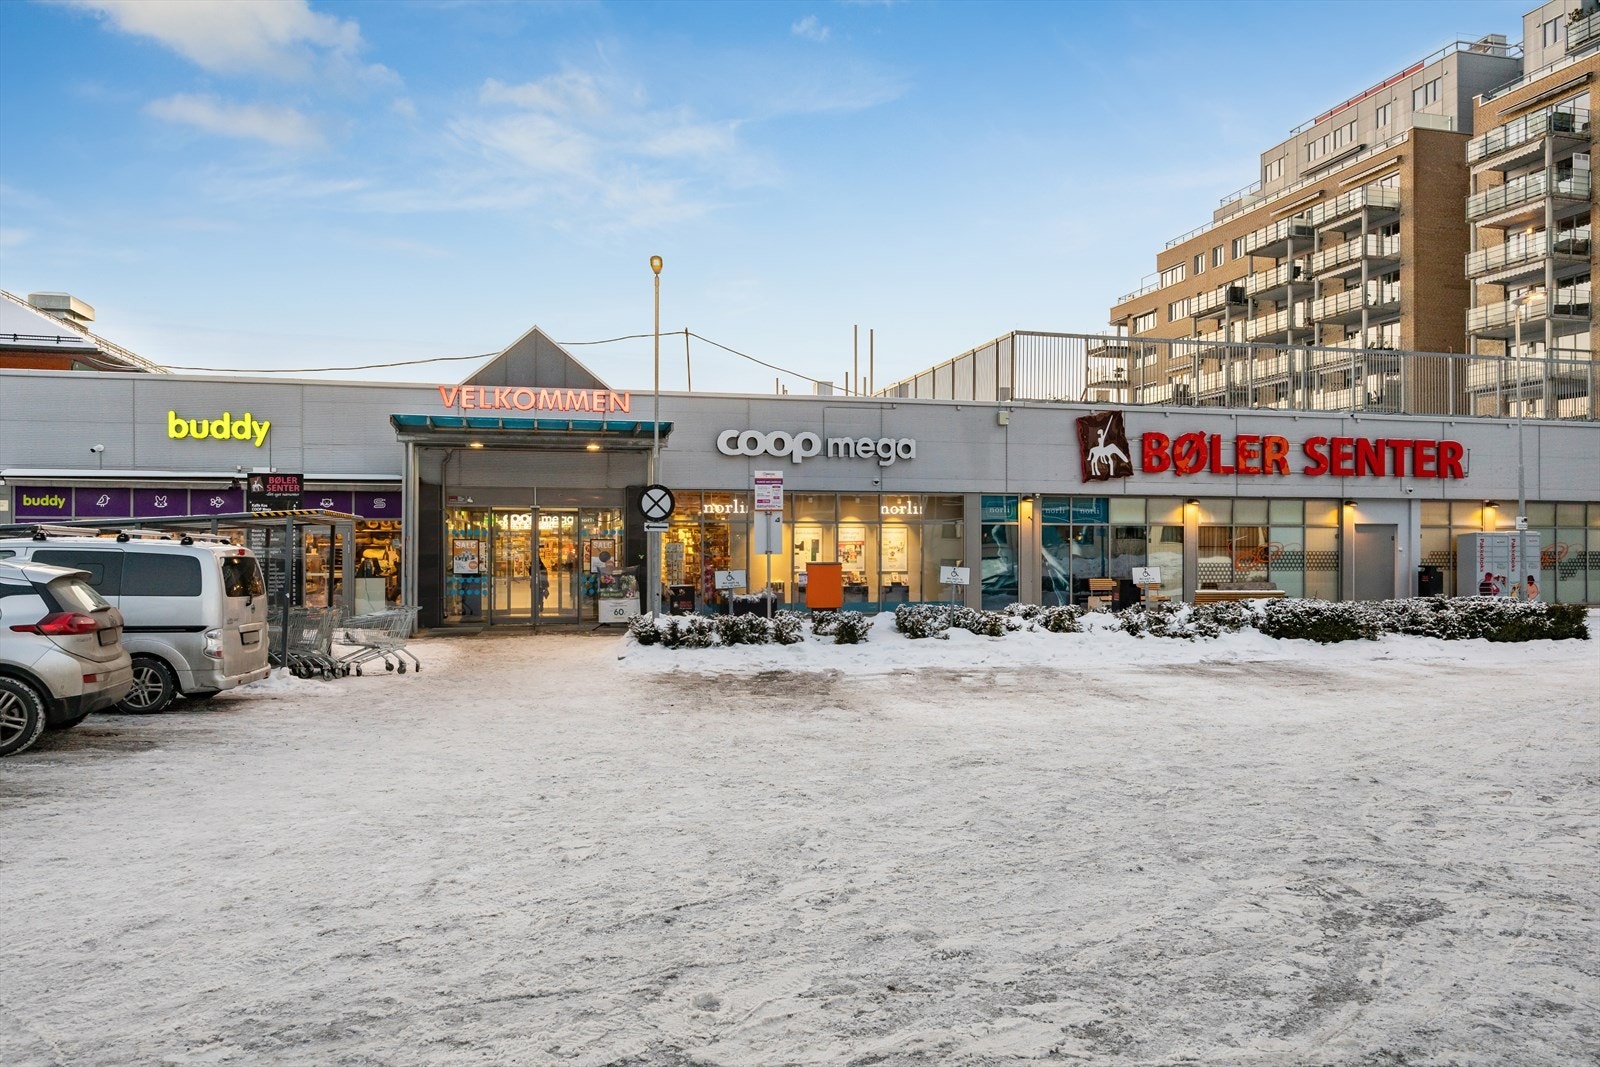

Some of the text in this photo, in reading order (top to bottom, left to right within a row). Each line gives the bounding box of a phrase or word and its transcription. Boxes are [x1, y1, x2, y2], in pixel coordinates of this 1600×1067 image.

[438, 385, 631, 413] VELKOMMEN
[168, 410, 271, 447] buddy
[716, 429, 917, 467] coop mega
[1141, 431, 1465, 479] BØLER SENTER
[268, 476, 298, 484] BØLER
[266, 484, 300, 492] SENTER
[23, 494, 66, 509] buddy
[989, 505, 1010, 514] norli
[1045, 506, 1065, 514] norli
[1080, 506, 1100, 515] norli
[613, 608, 625, 616] 60
